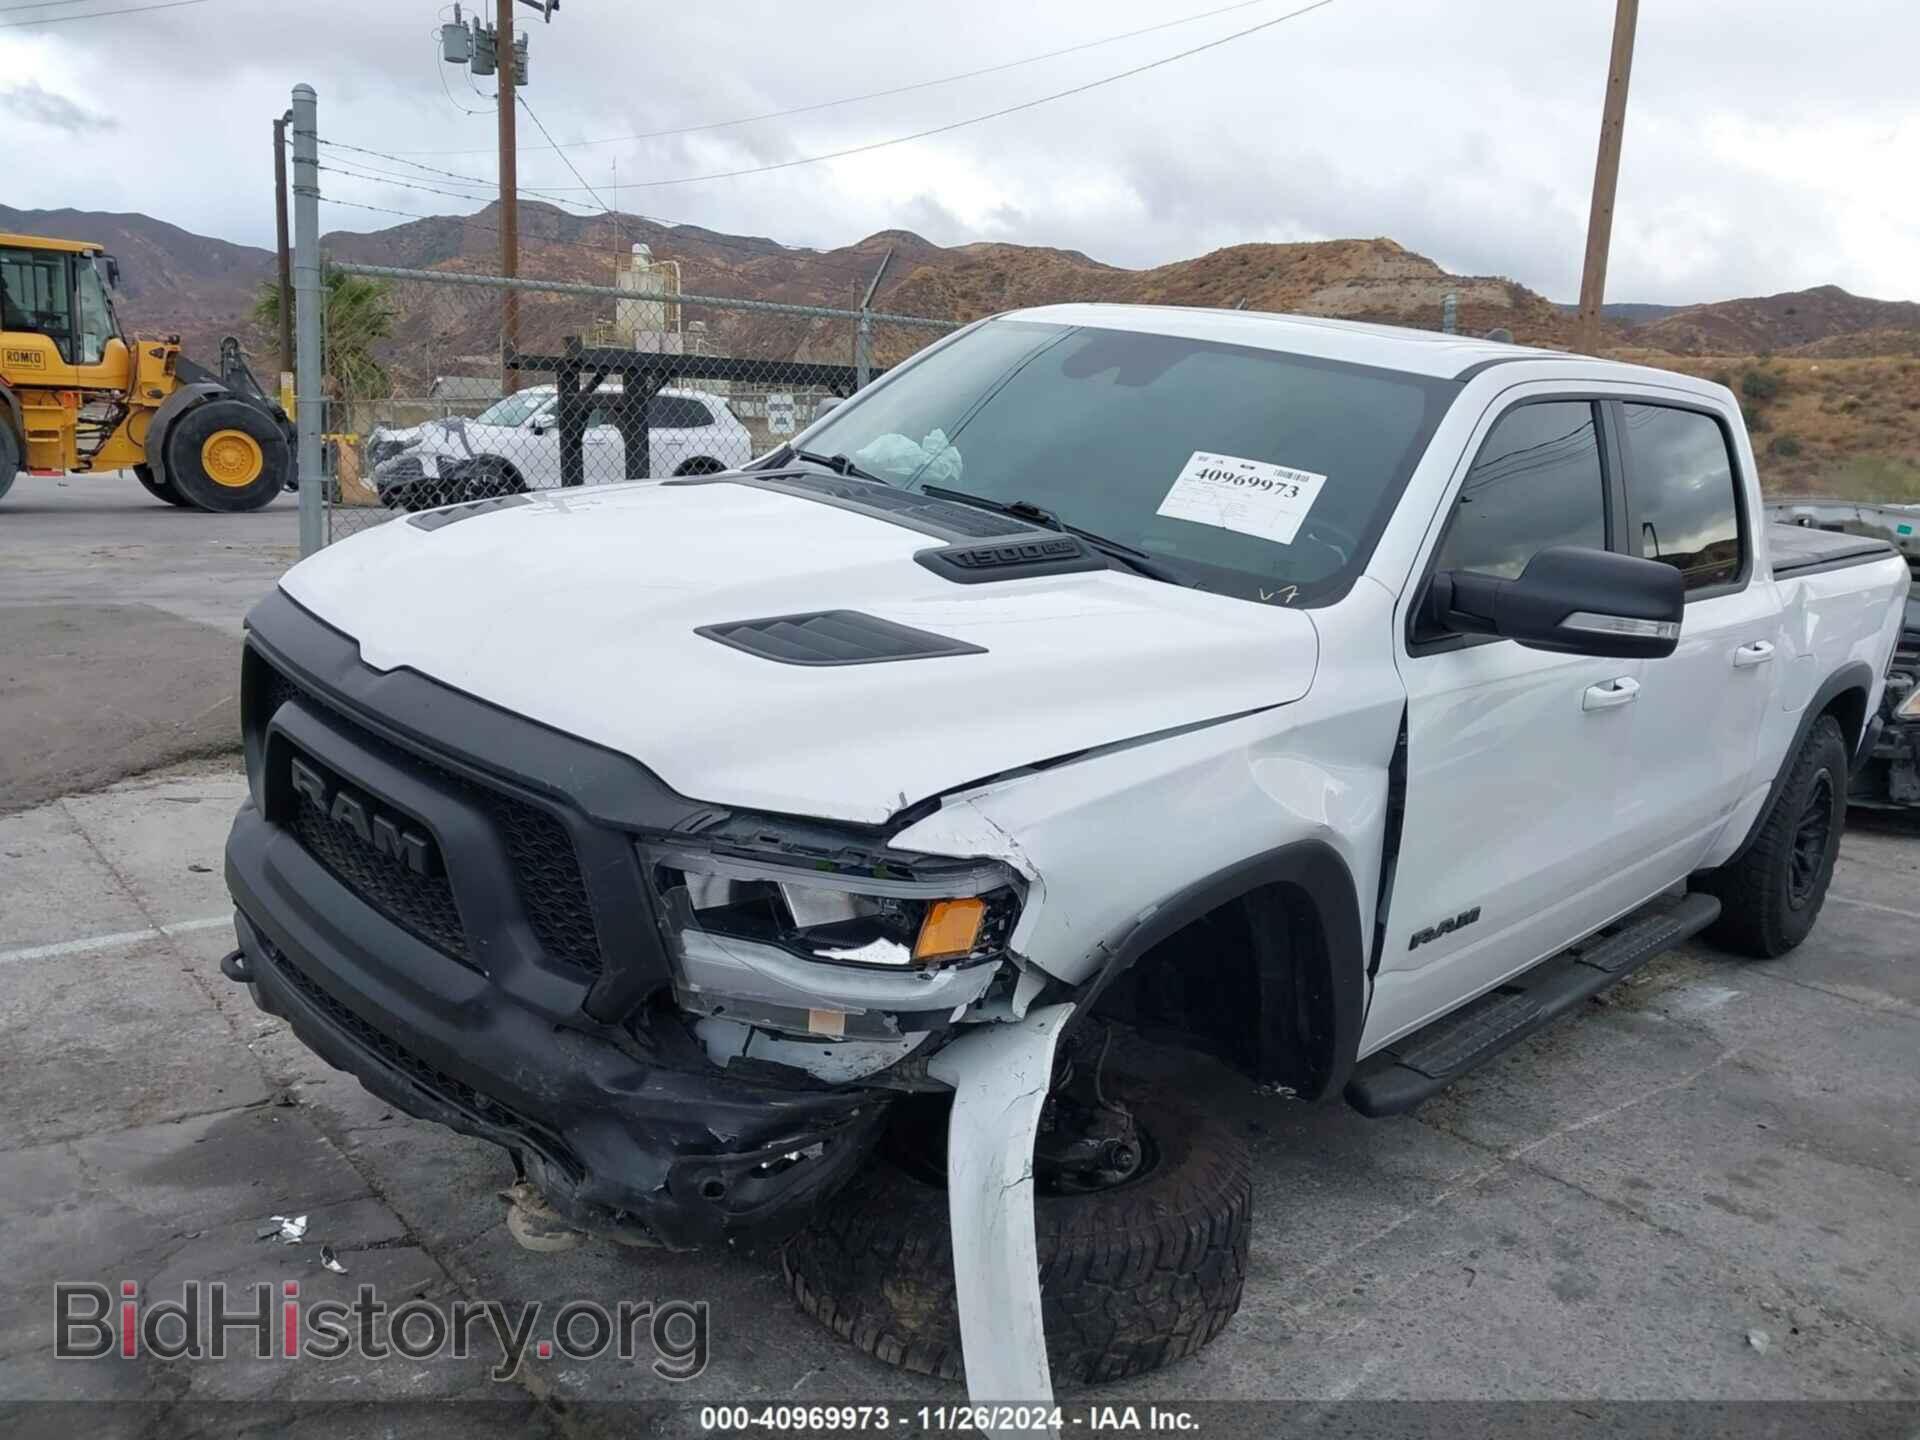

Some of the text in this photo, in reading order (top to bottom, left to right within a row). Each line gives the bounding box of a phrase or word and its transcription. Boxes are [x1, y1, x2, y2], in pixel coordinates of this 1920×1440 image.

[1195, 468, 1300, 498] 40969973
[957, 545, 1040, 566] 1500
[291, 757, 428, 874] RAM
[1408, 906, 1481, 951] RAM
